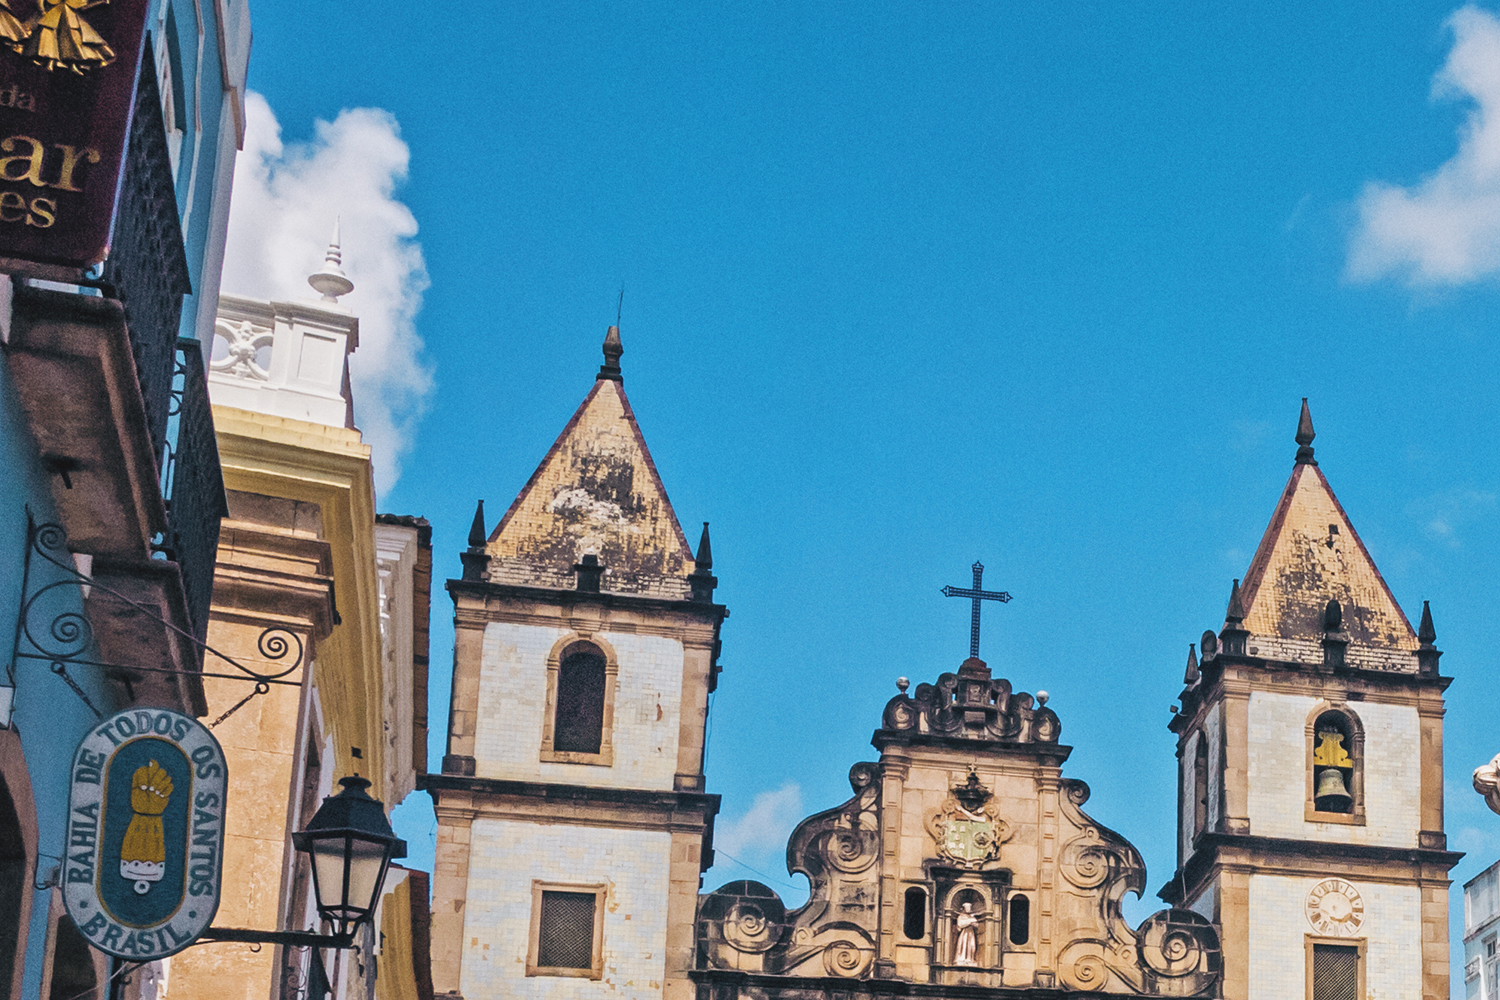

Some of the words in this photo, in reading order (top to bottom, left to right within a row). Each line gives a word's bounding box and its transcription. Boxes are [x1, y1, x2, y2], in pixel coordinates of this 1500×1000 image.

[96, 711, 193, 748] TODOS
[75, 747, 107, 785] DE
[190, 745, 222, 780] OS
[68, 802, 101, 885] BAHIA
[188, 791, 221, 897] SANTOS
[80, 911, 192, 955] BRASIL
